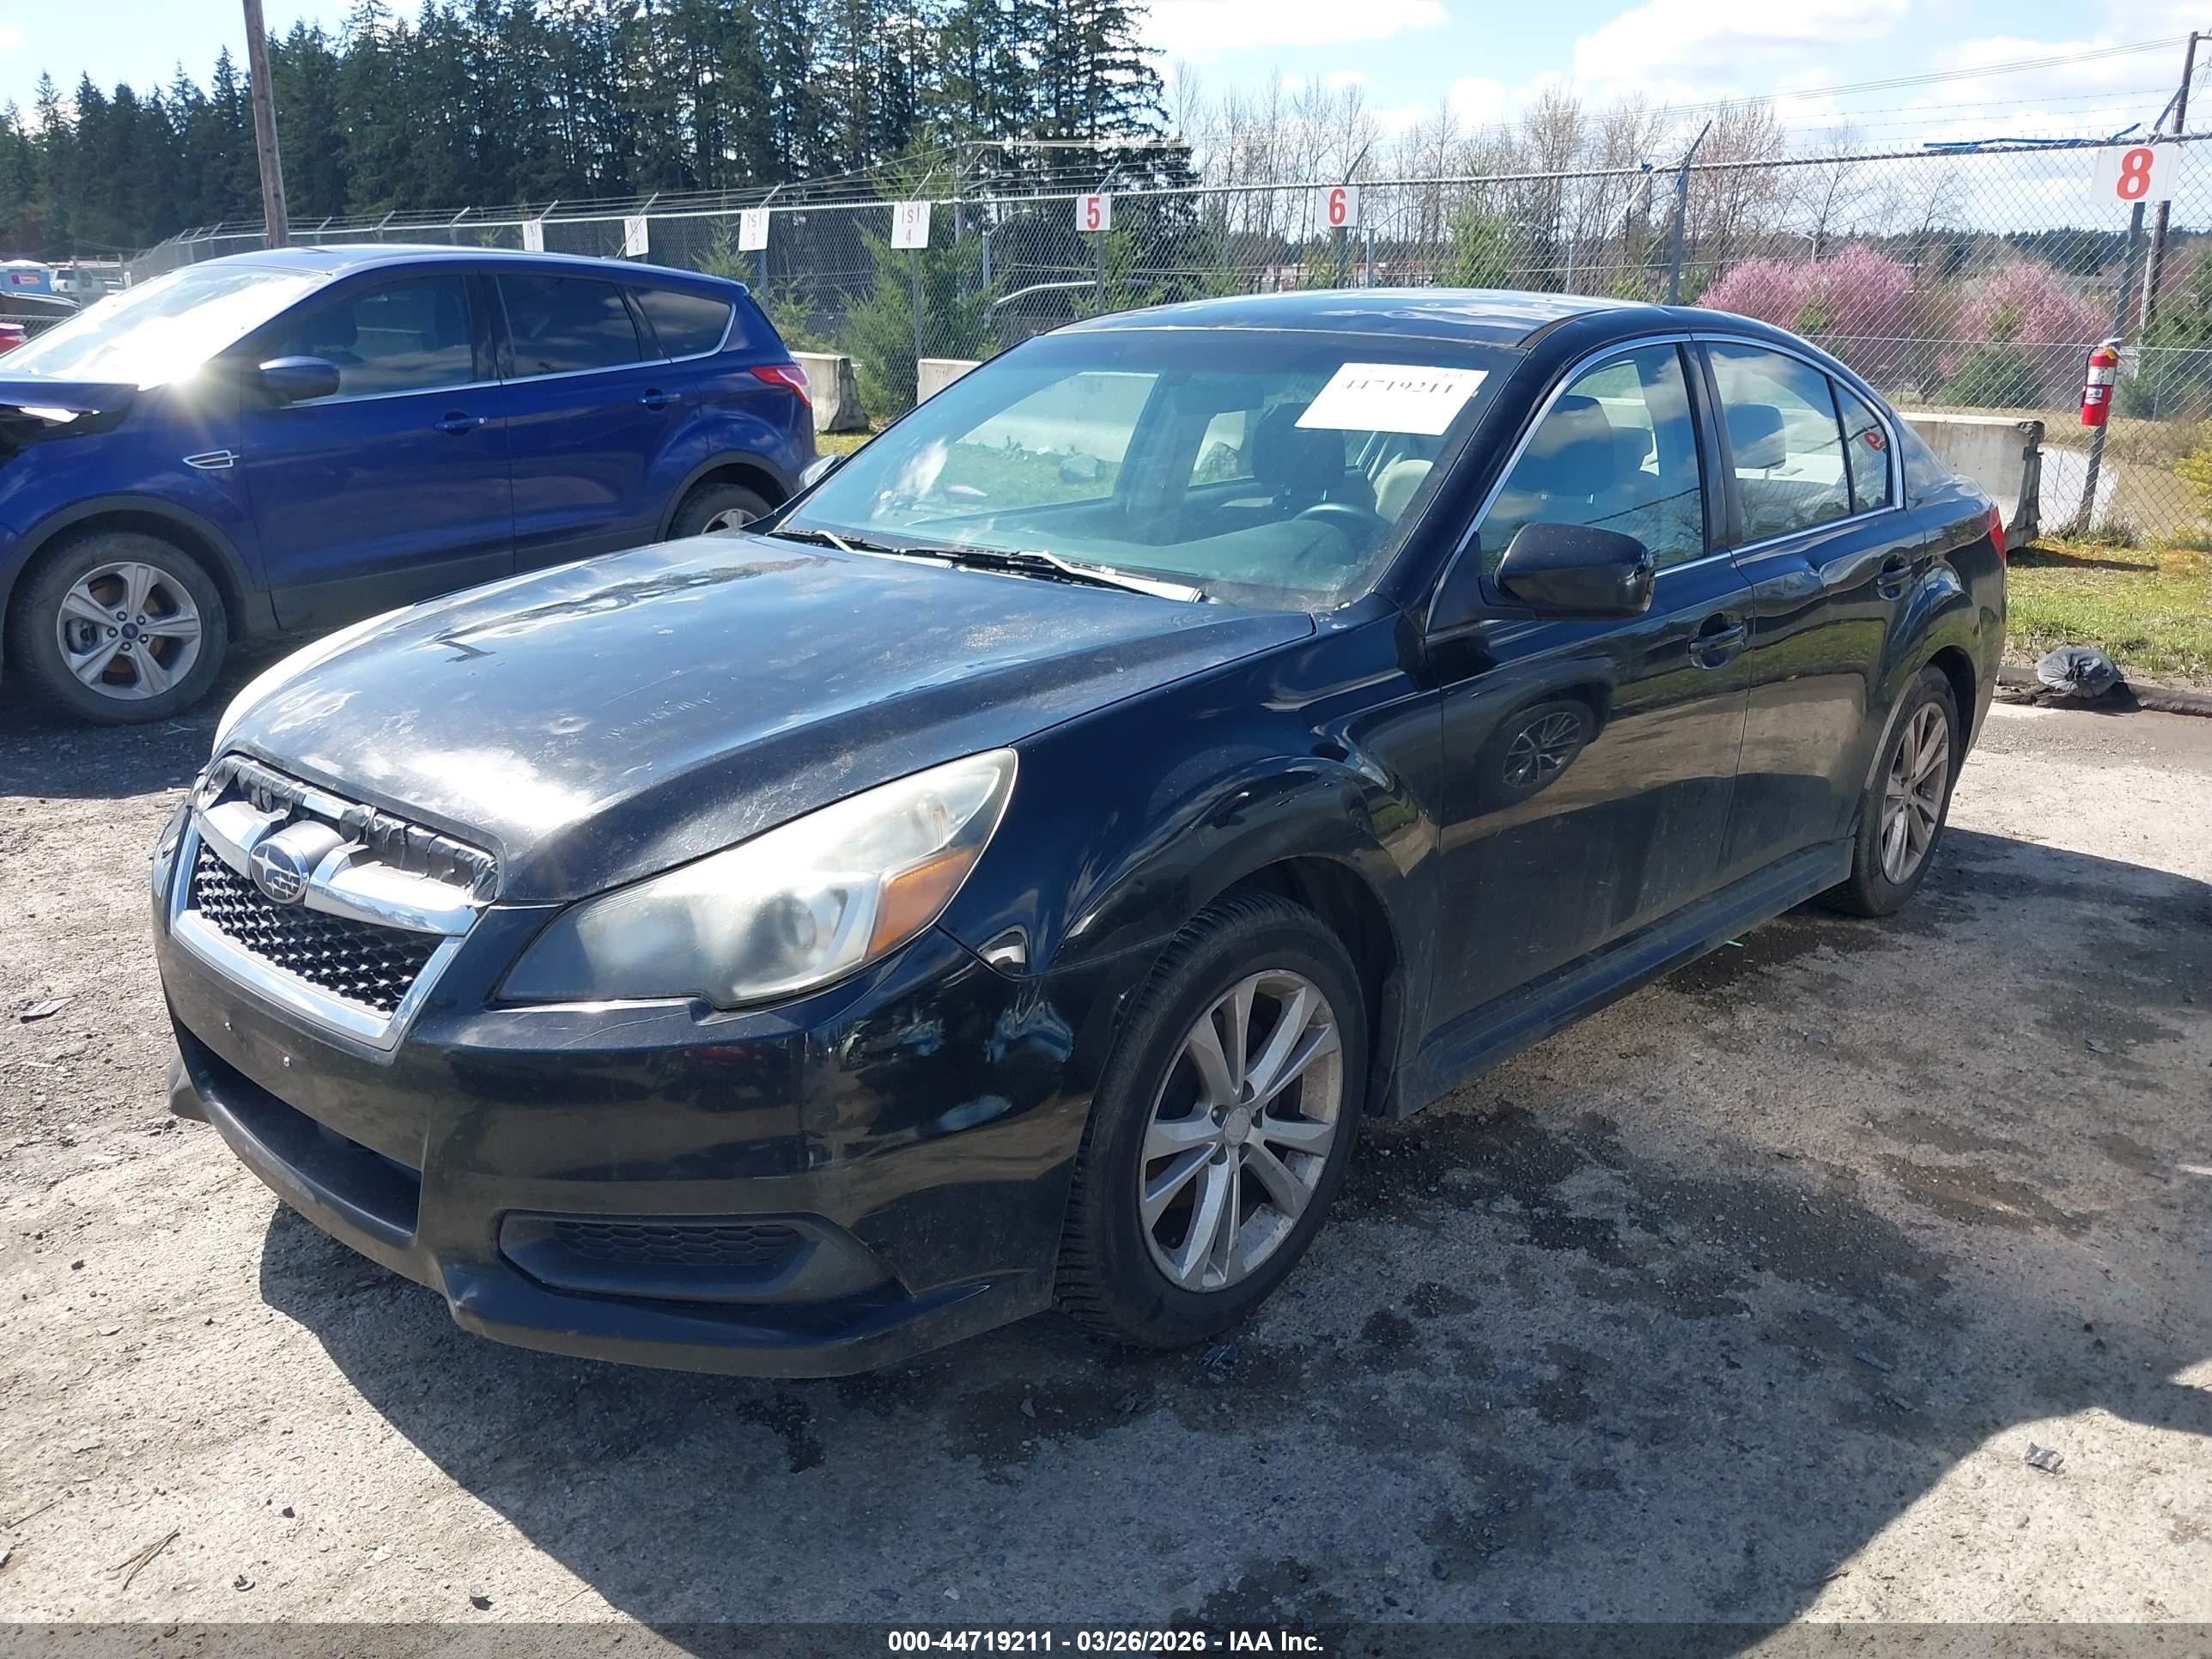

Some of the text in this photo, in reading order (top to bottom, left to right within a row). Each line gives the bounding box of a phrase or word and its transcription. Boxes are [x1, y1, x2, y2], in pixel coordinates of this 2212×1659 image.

[2116, 148, 2154, 200] 8
[1086, 197, 1100, 229] 5
[1329, 188, 1346, 225] 6
[750, 233, 757, 246] 3
[904, 228, 913, 245] 4
